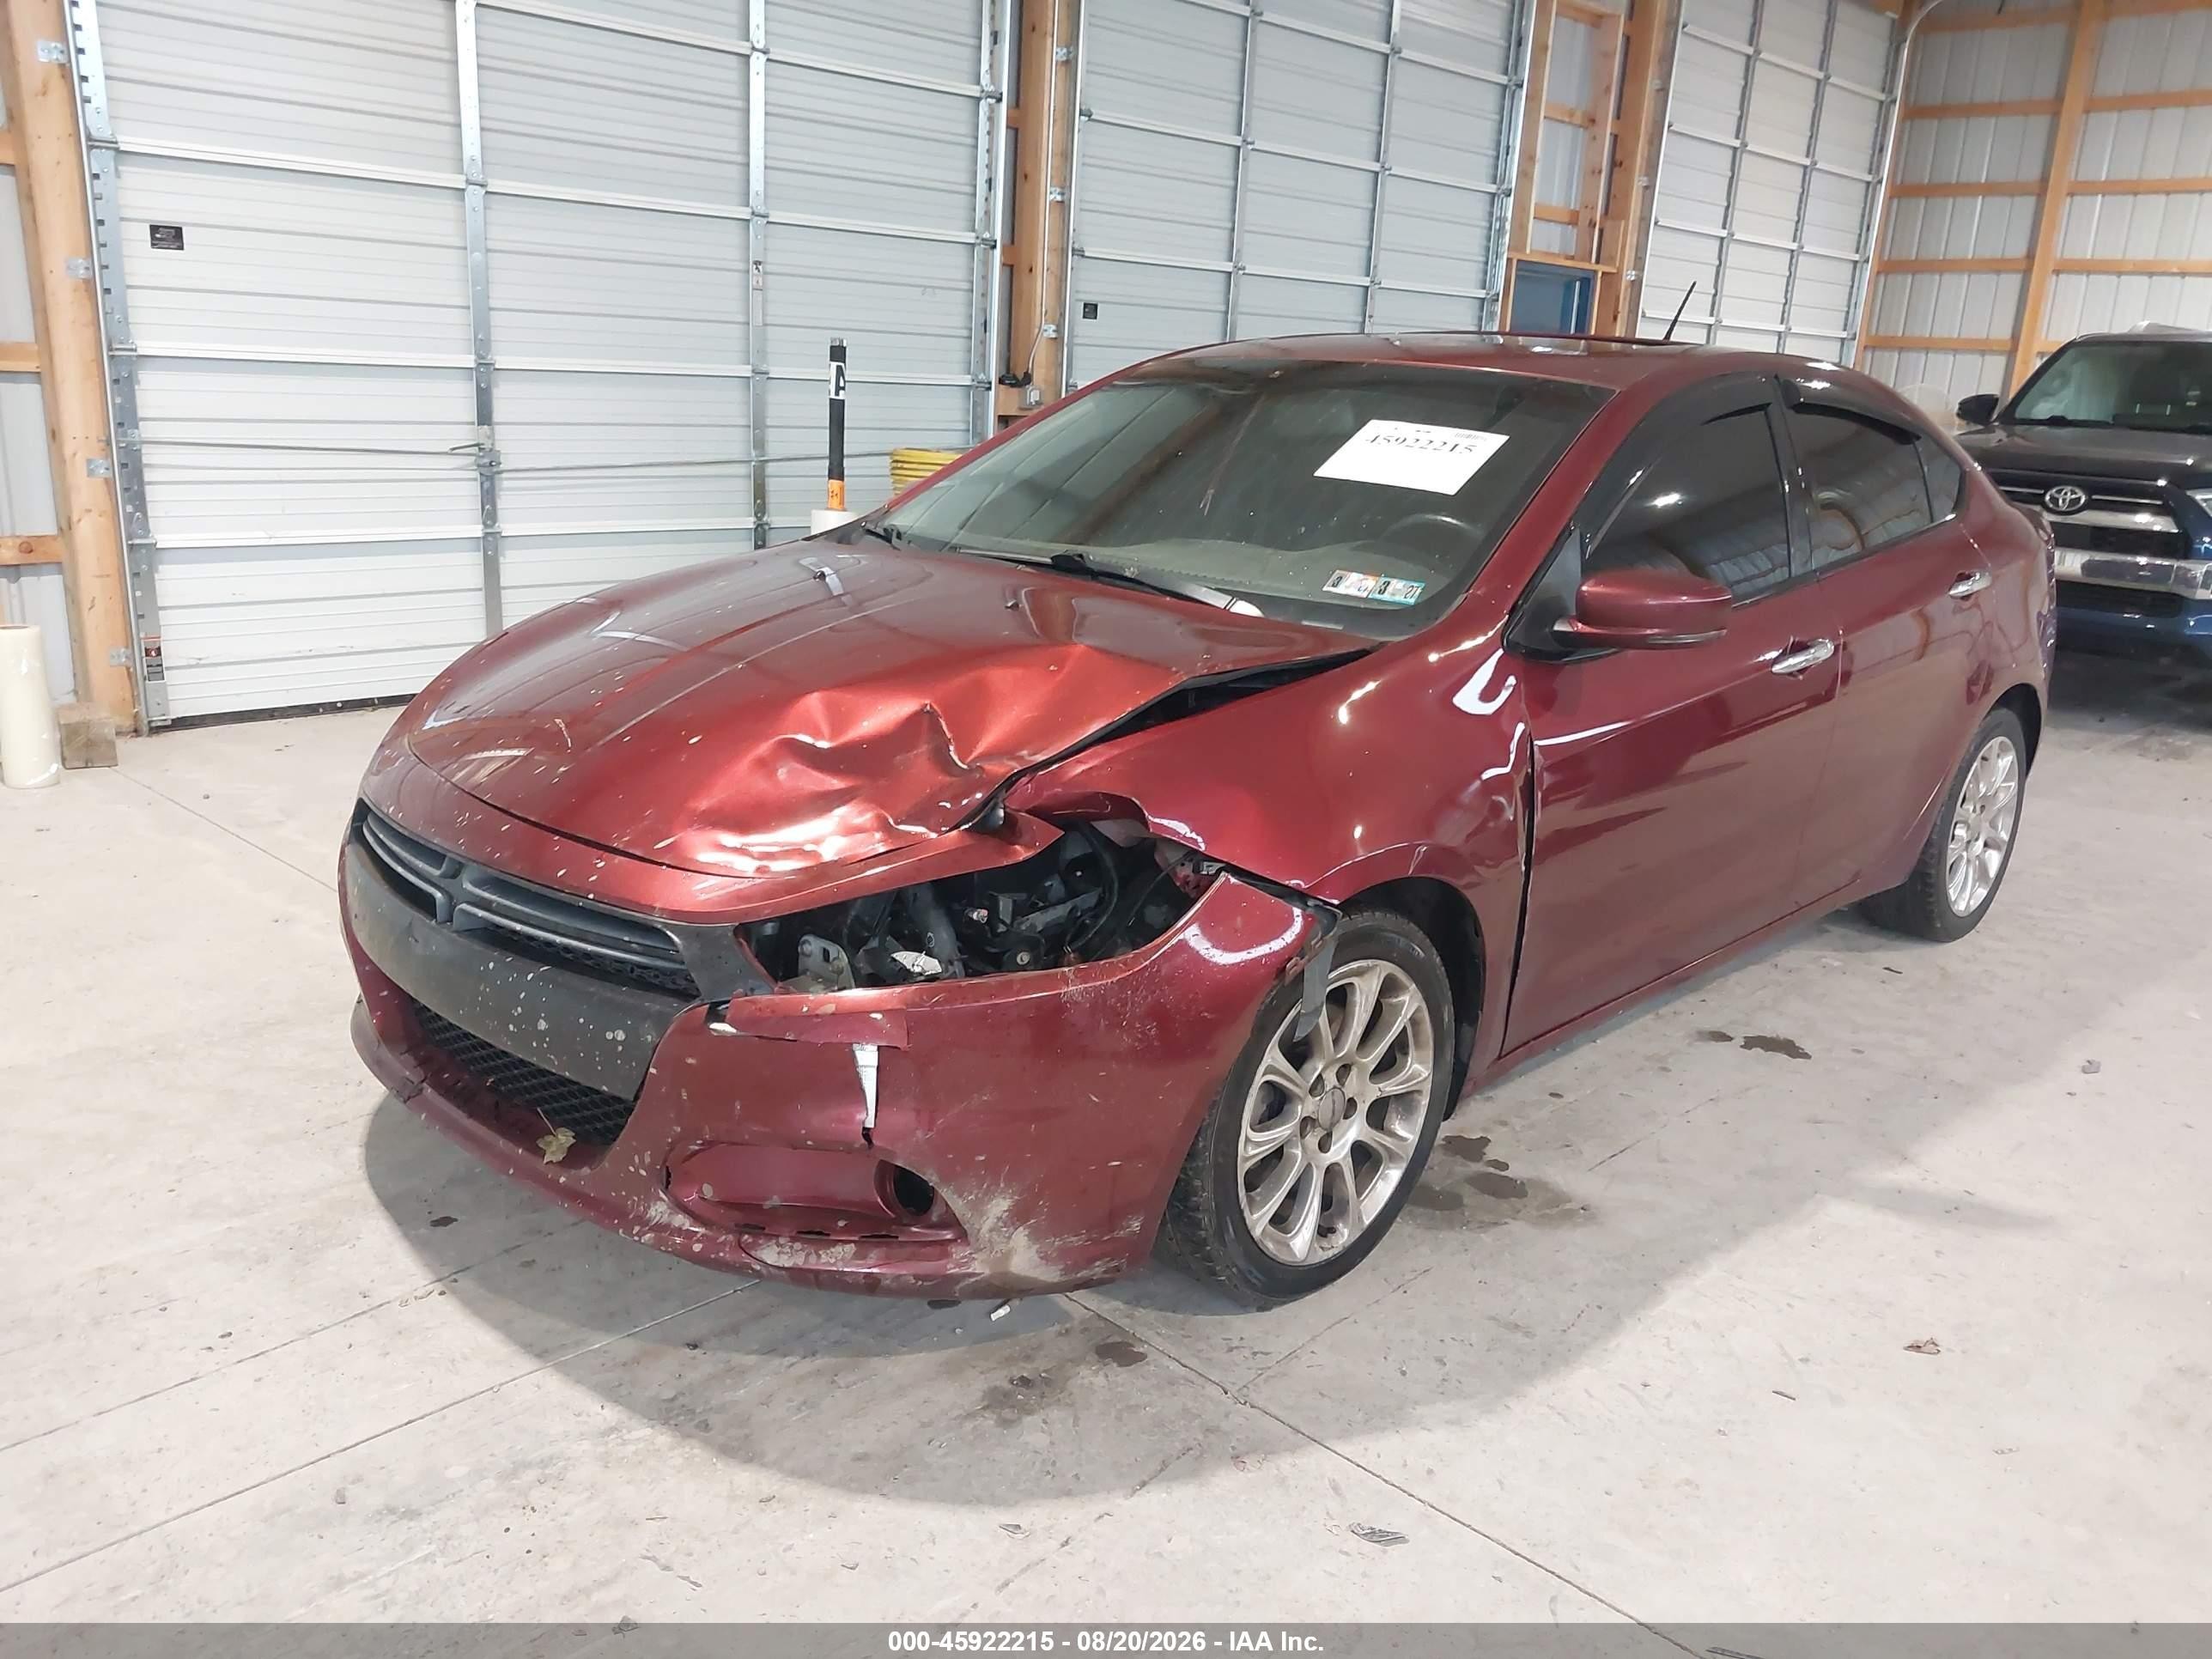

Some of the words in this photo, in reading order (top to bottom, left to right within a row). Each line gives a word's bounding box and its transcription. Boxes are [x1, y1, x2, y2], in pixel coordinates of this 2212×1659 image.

[1365, 434, 1477, 453] 45922215
[1377, 580, 1390, 595] 3
[1403, 585, 1419, 600] 27
